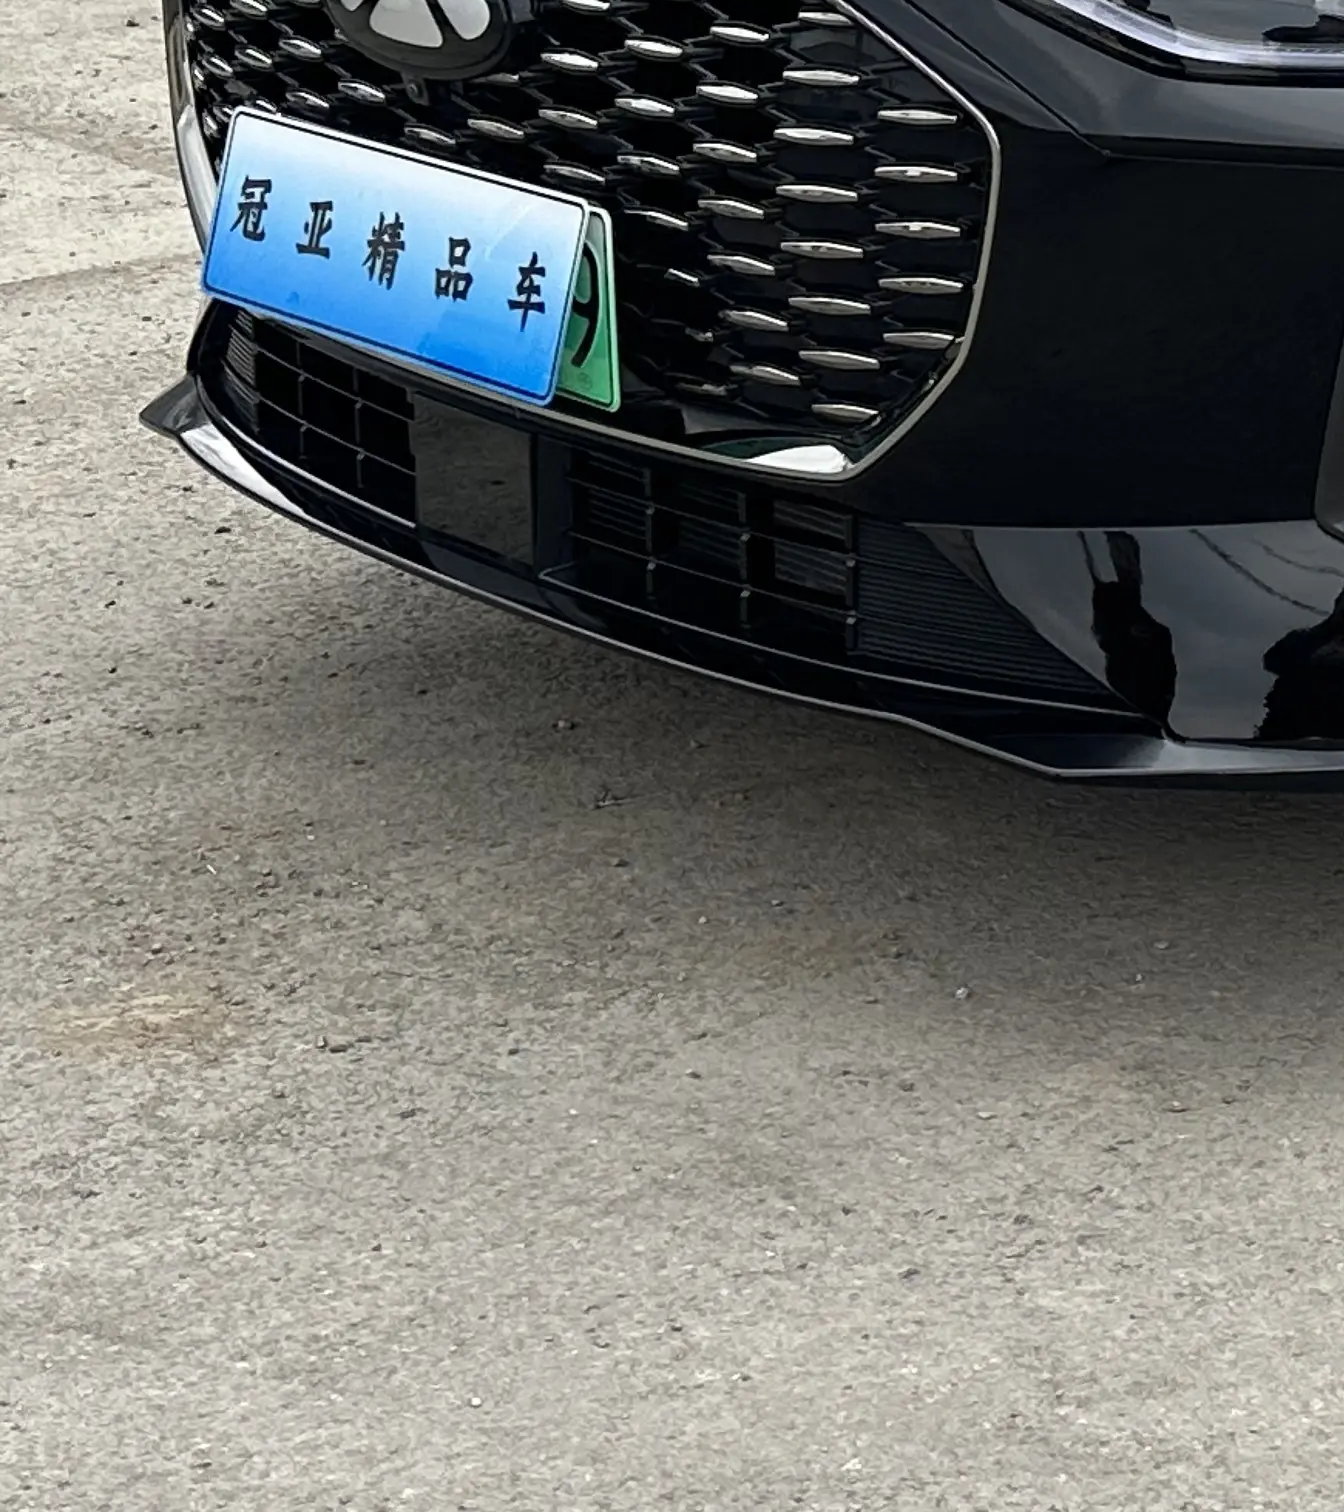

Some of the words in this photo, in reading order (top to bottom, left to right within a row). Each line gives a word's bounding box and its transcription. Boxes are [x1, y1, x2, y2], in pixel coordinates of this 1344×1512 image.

[230, 175, 546, 332] 冠亚精品车
